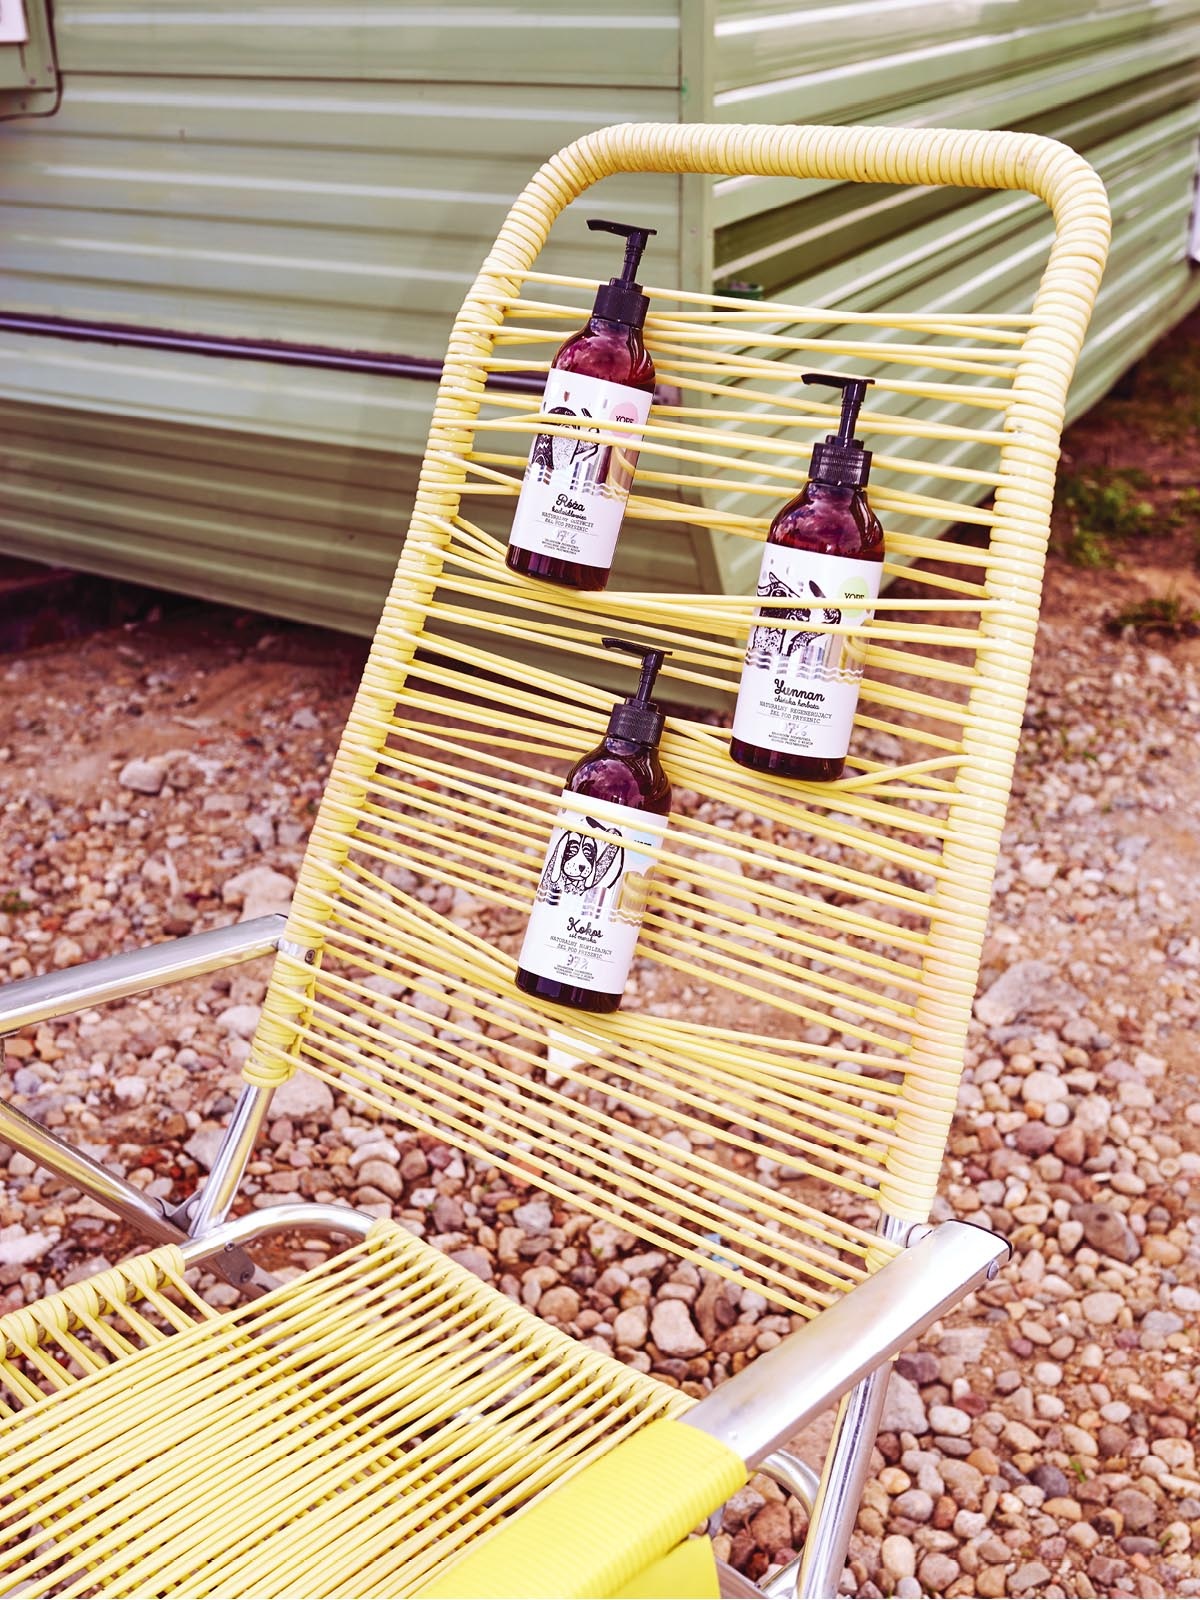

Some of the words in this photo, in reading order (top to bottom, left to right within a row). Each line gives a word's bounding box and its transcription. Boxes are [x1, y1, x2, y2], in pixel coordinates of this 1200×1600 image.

[555, 493, 586, 512] Róża
[774, 678, 825, 702] Yunnan
[759, 700, 789, 712] NATURALNY
[797, 699, 820, 710] herbata
[792, 714, 821, 724] PRYSZNIC
[566, 916, 604, 938] Kokos
[549, 935, 578, 947] NATURALNY
